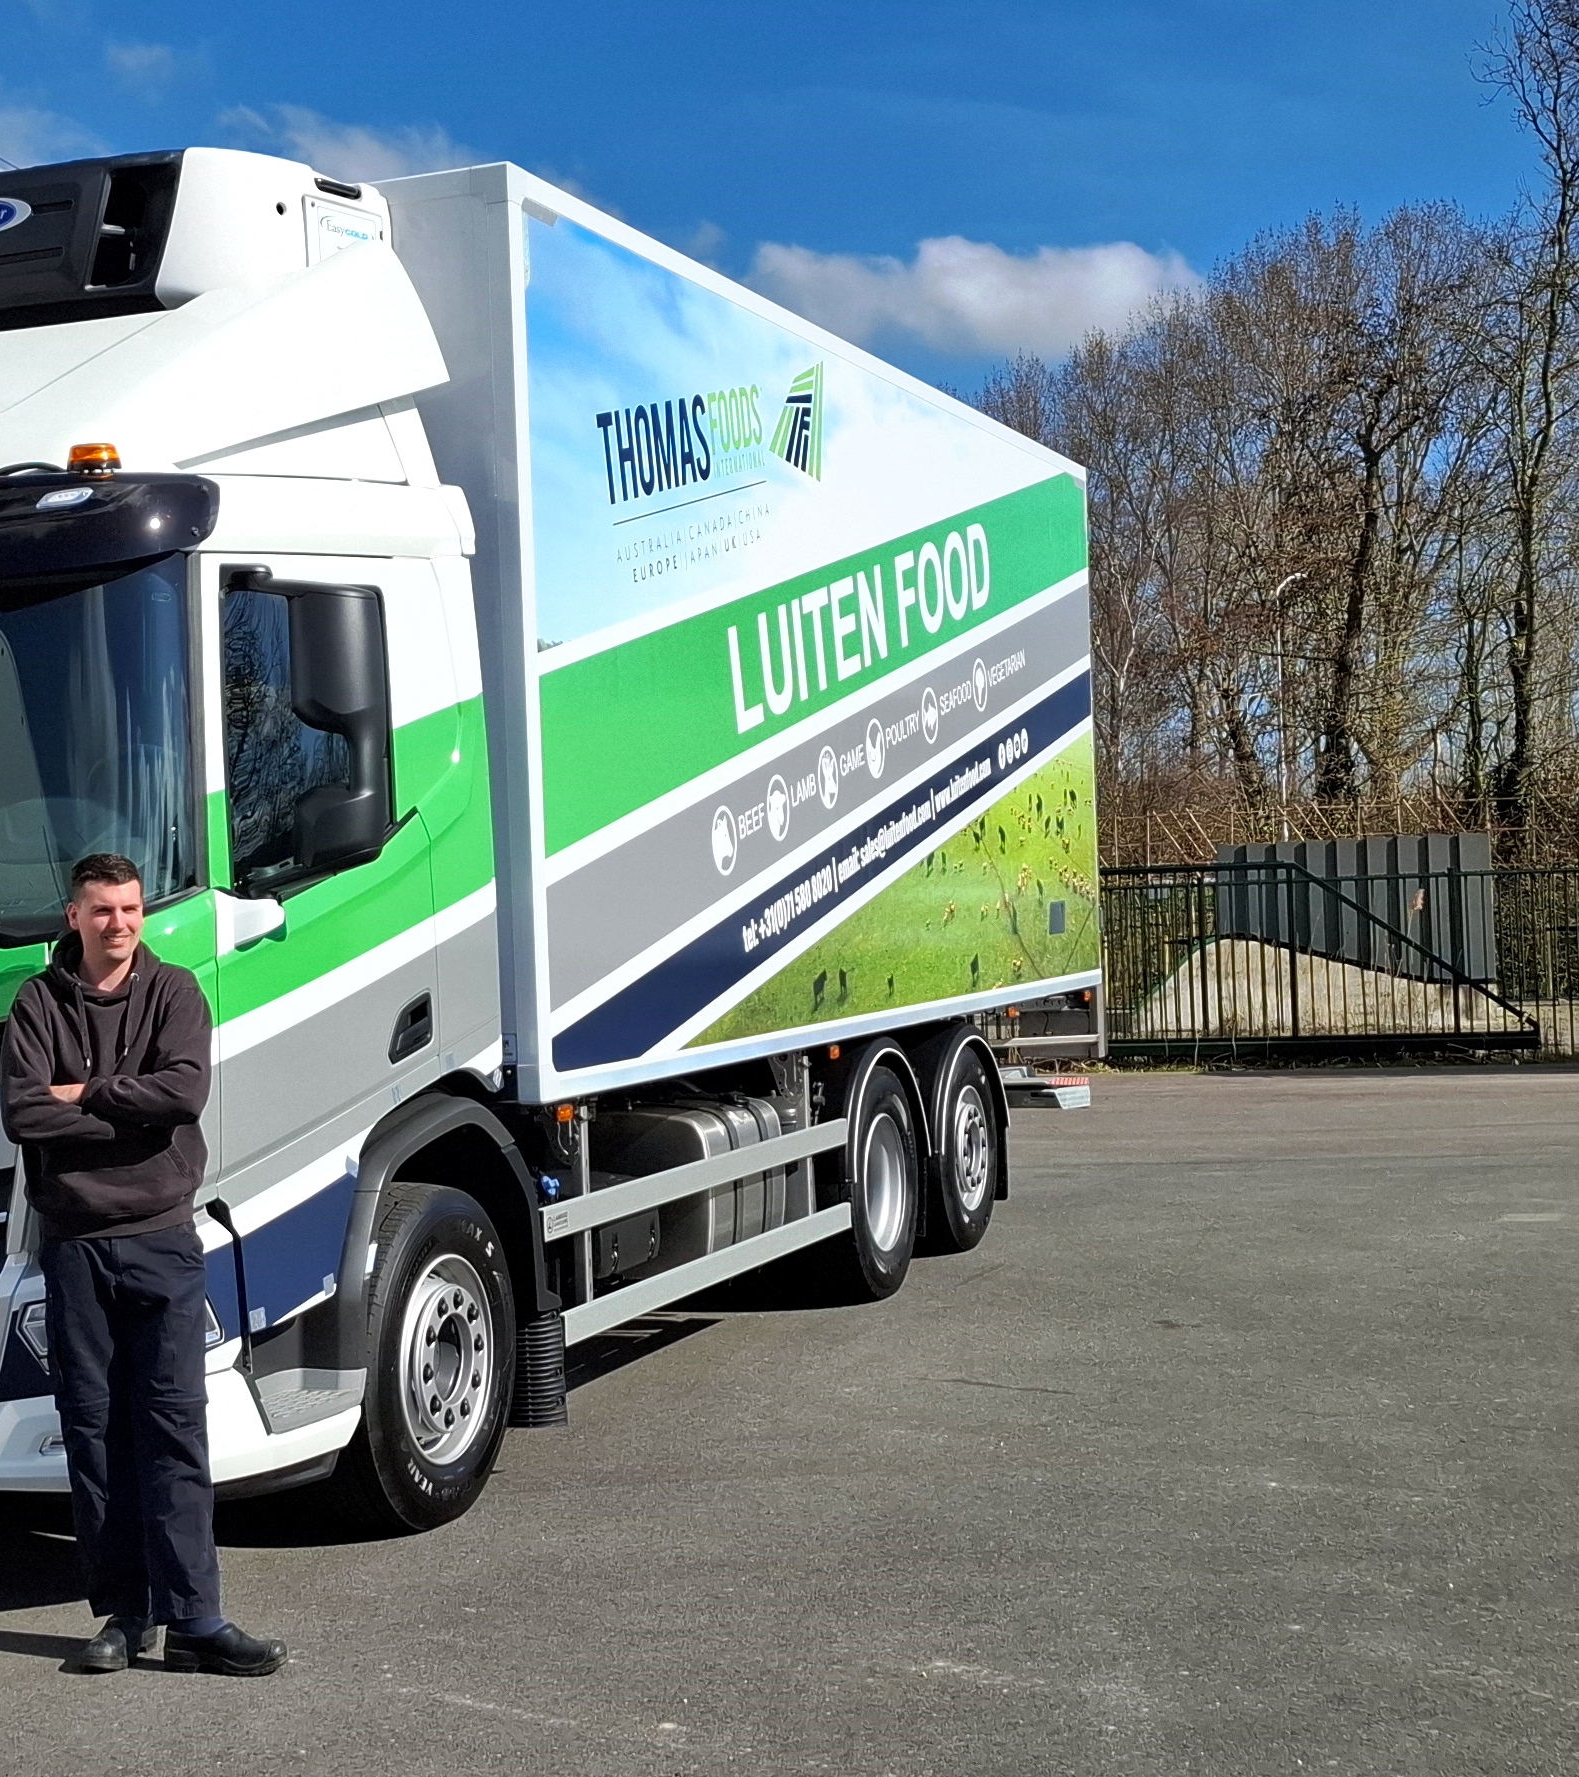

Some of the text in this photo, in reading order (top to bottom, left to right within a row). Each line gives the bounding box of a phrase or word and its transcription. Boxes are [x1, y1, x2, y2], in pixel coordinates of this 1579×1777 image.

[596, 384, 763, 505] THOMAS FOODS
[713, 451, 766, 479] INTERNATIONAL
[632, 555, 678, 583] EUROPE
[723, 535, 738, 553] UK
[743, 529, 762, 547] USA
[727, 522, 991, 734] LUITEN FOOD
[738, 649, 1026, 840] BEEF LAMB GAME POULTRY SEAFOOD VEGETARIAN
[742, 919, 759, 953] tel:
[794, 880, 812, 915] 580
[811, 864, 833, 903] 8020
[838, 846, 860, 884] email:
[860, 800, 932, 868] sales@luitenfood.com
[935, 758, 992, 813] www.luitenfood.com
